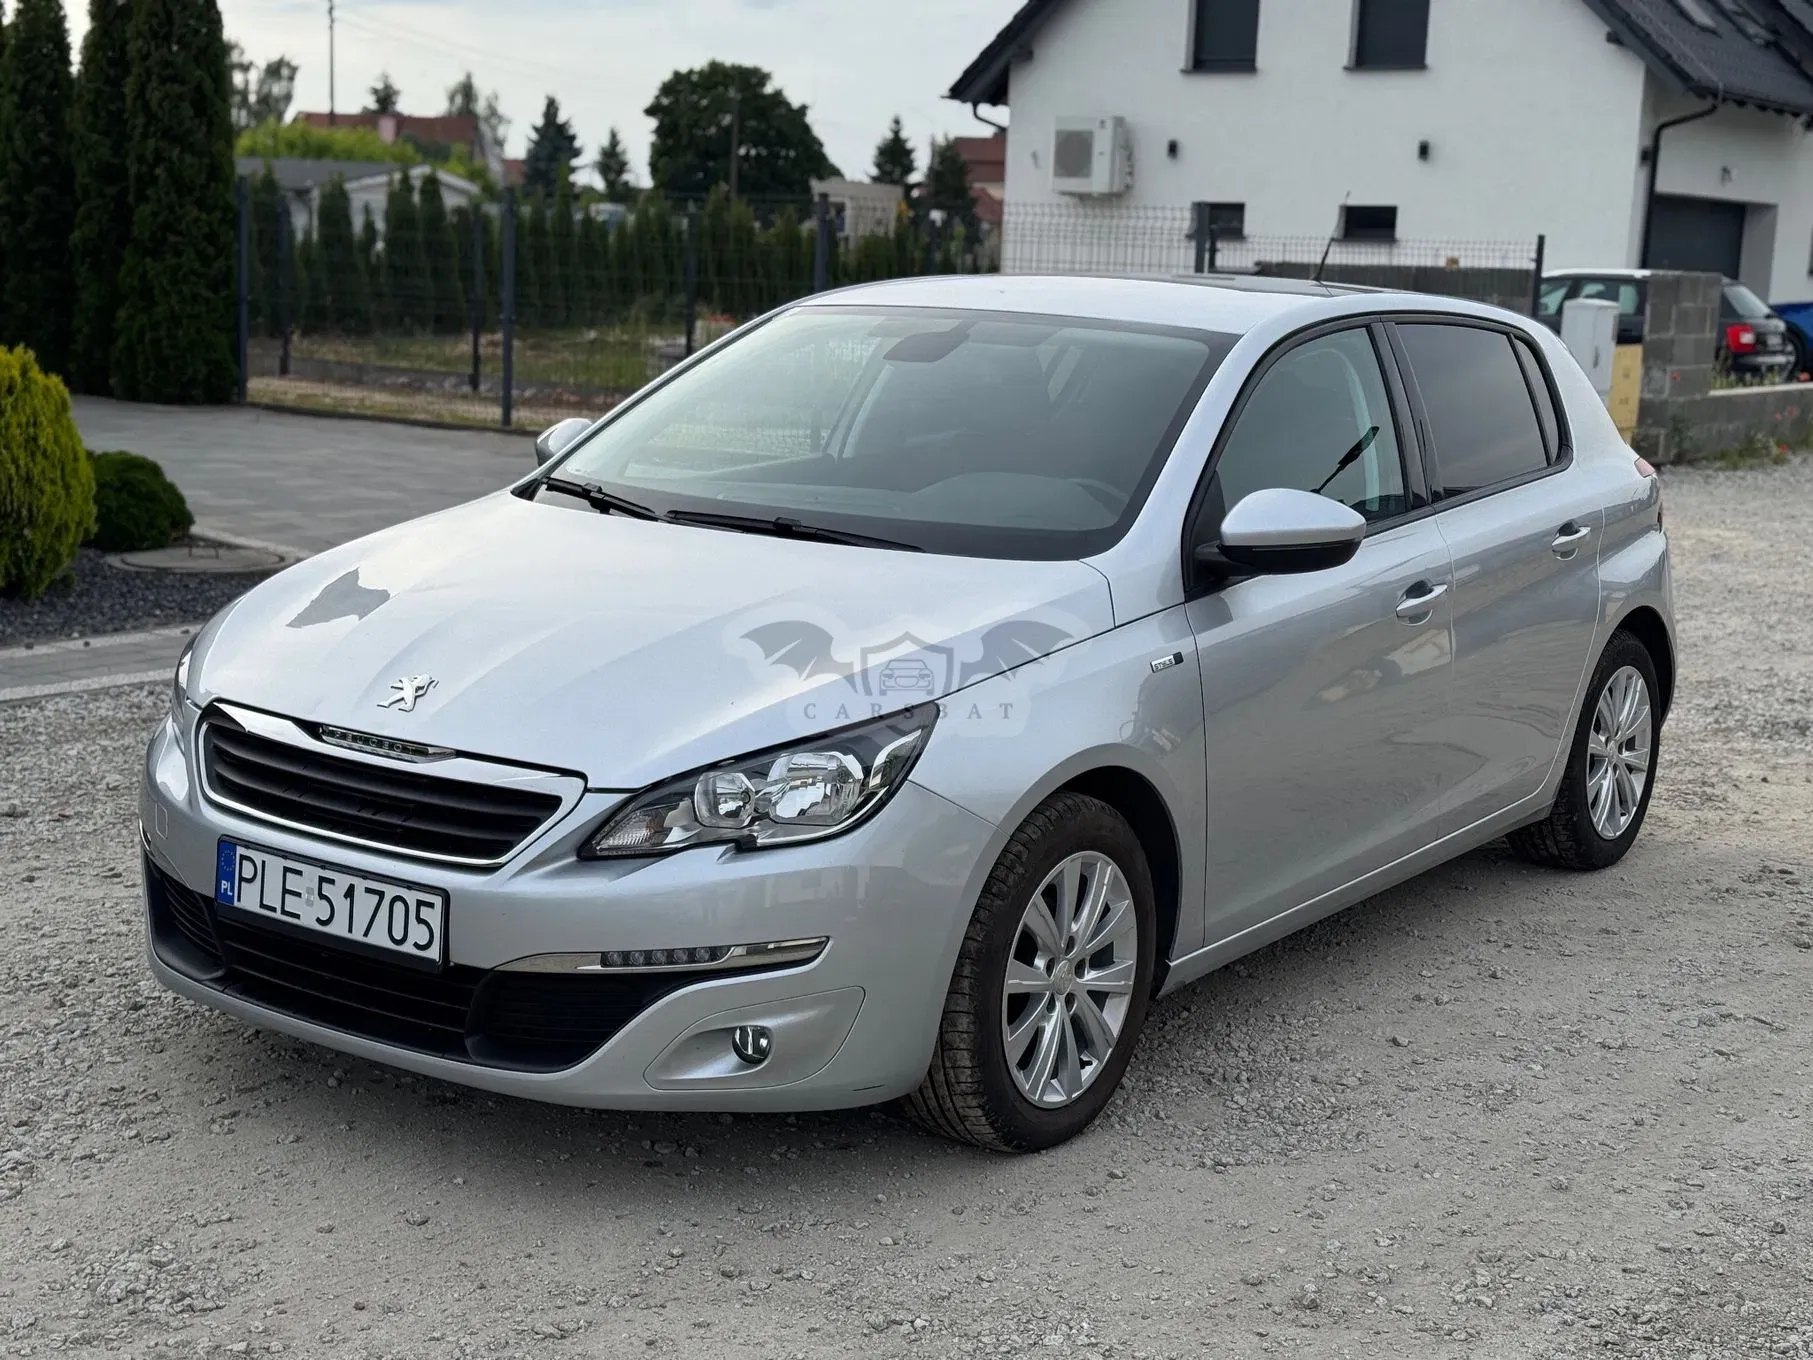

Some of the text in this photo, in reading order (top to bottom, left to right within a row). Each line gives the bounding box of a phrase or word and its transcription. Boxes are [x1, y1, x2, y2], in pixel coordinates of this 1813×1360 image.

[221, 880, 233, 896] PL
[237, 853, 435, 951] PLE 51705
